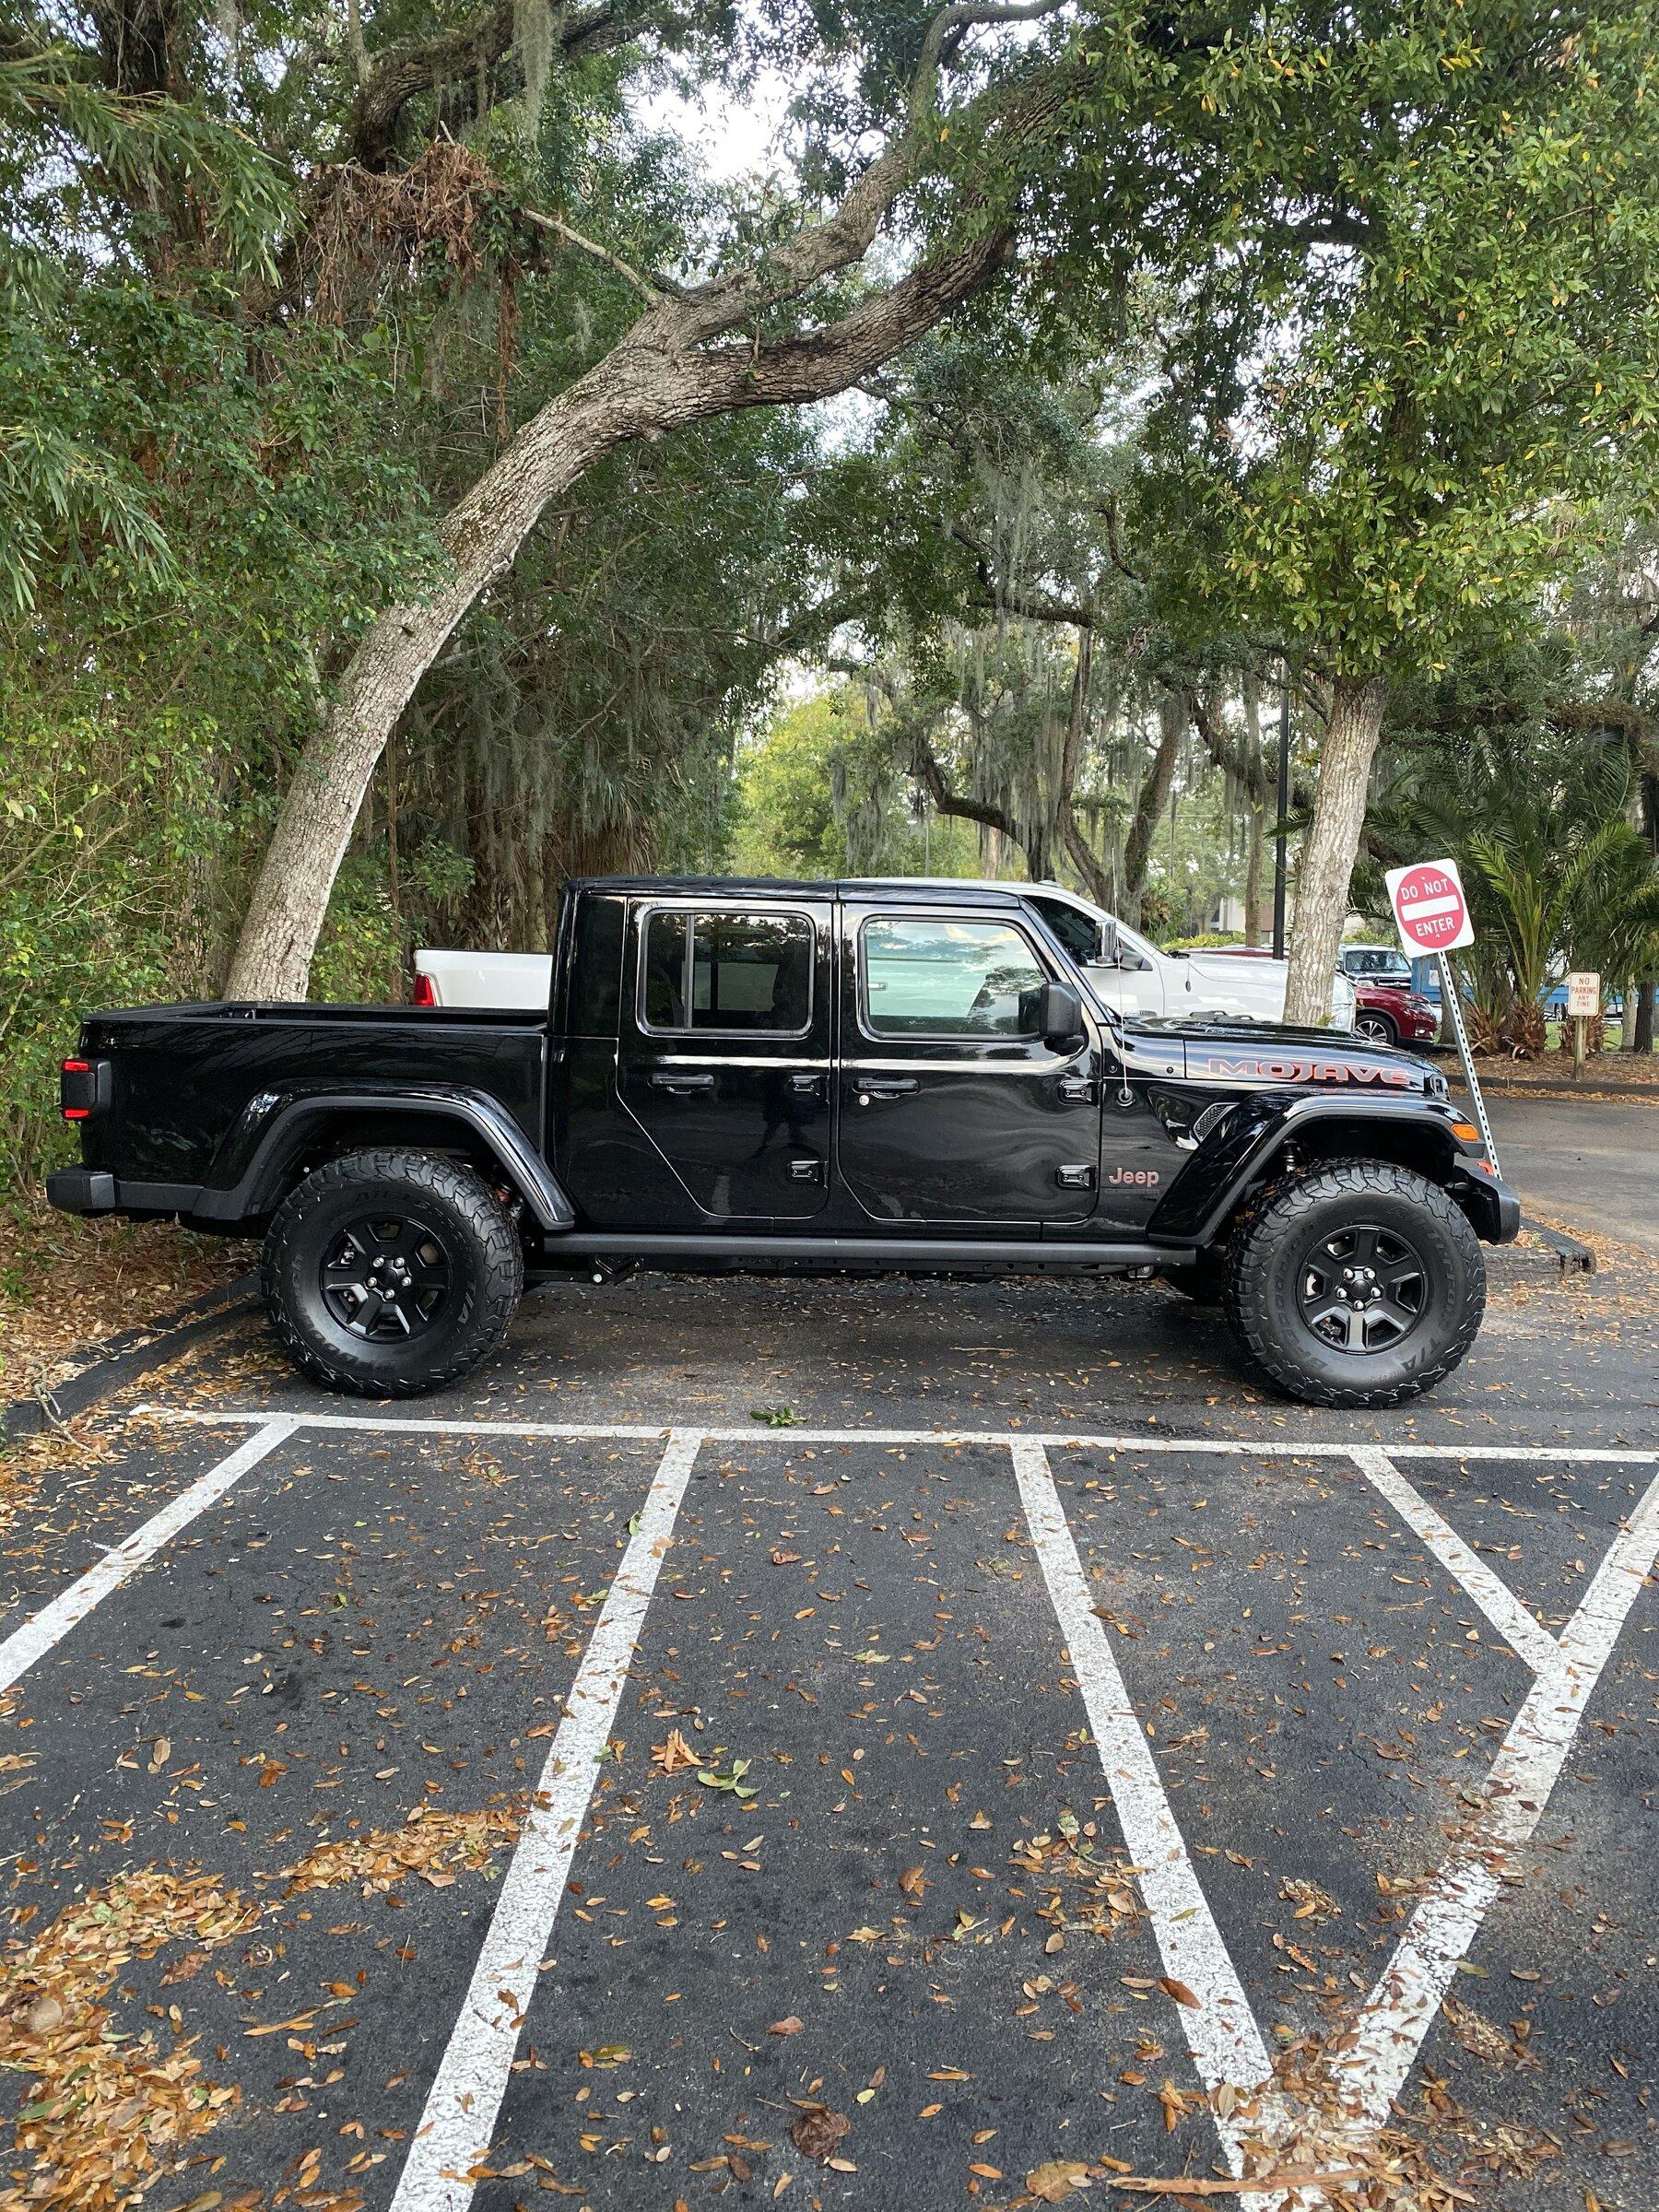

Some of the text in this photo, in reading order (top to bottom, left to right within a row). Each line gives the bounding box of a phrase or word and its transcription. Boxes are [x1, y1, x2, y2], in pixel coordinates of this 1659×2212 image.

[1401, 878, 1449, 900] DO NOT
[1416, 917, 1455, 937] ENTER
[1571, 986, 1597, 995] PARKING
[1578, 977, 1590, 985] NO
[1208, 1058, 1410, 1086] MOJAVE
[1108, 1167, 1160, 1188] Jeep
